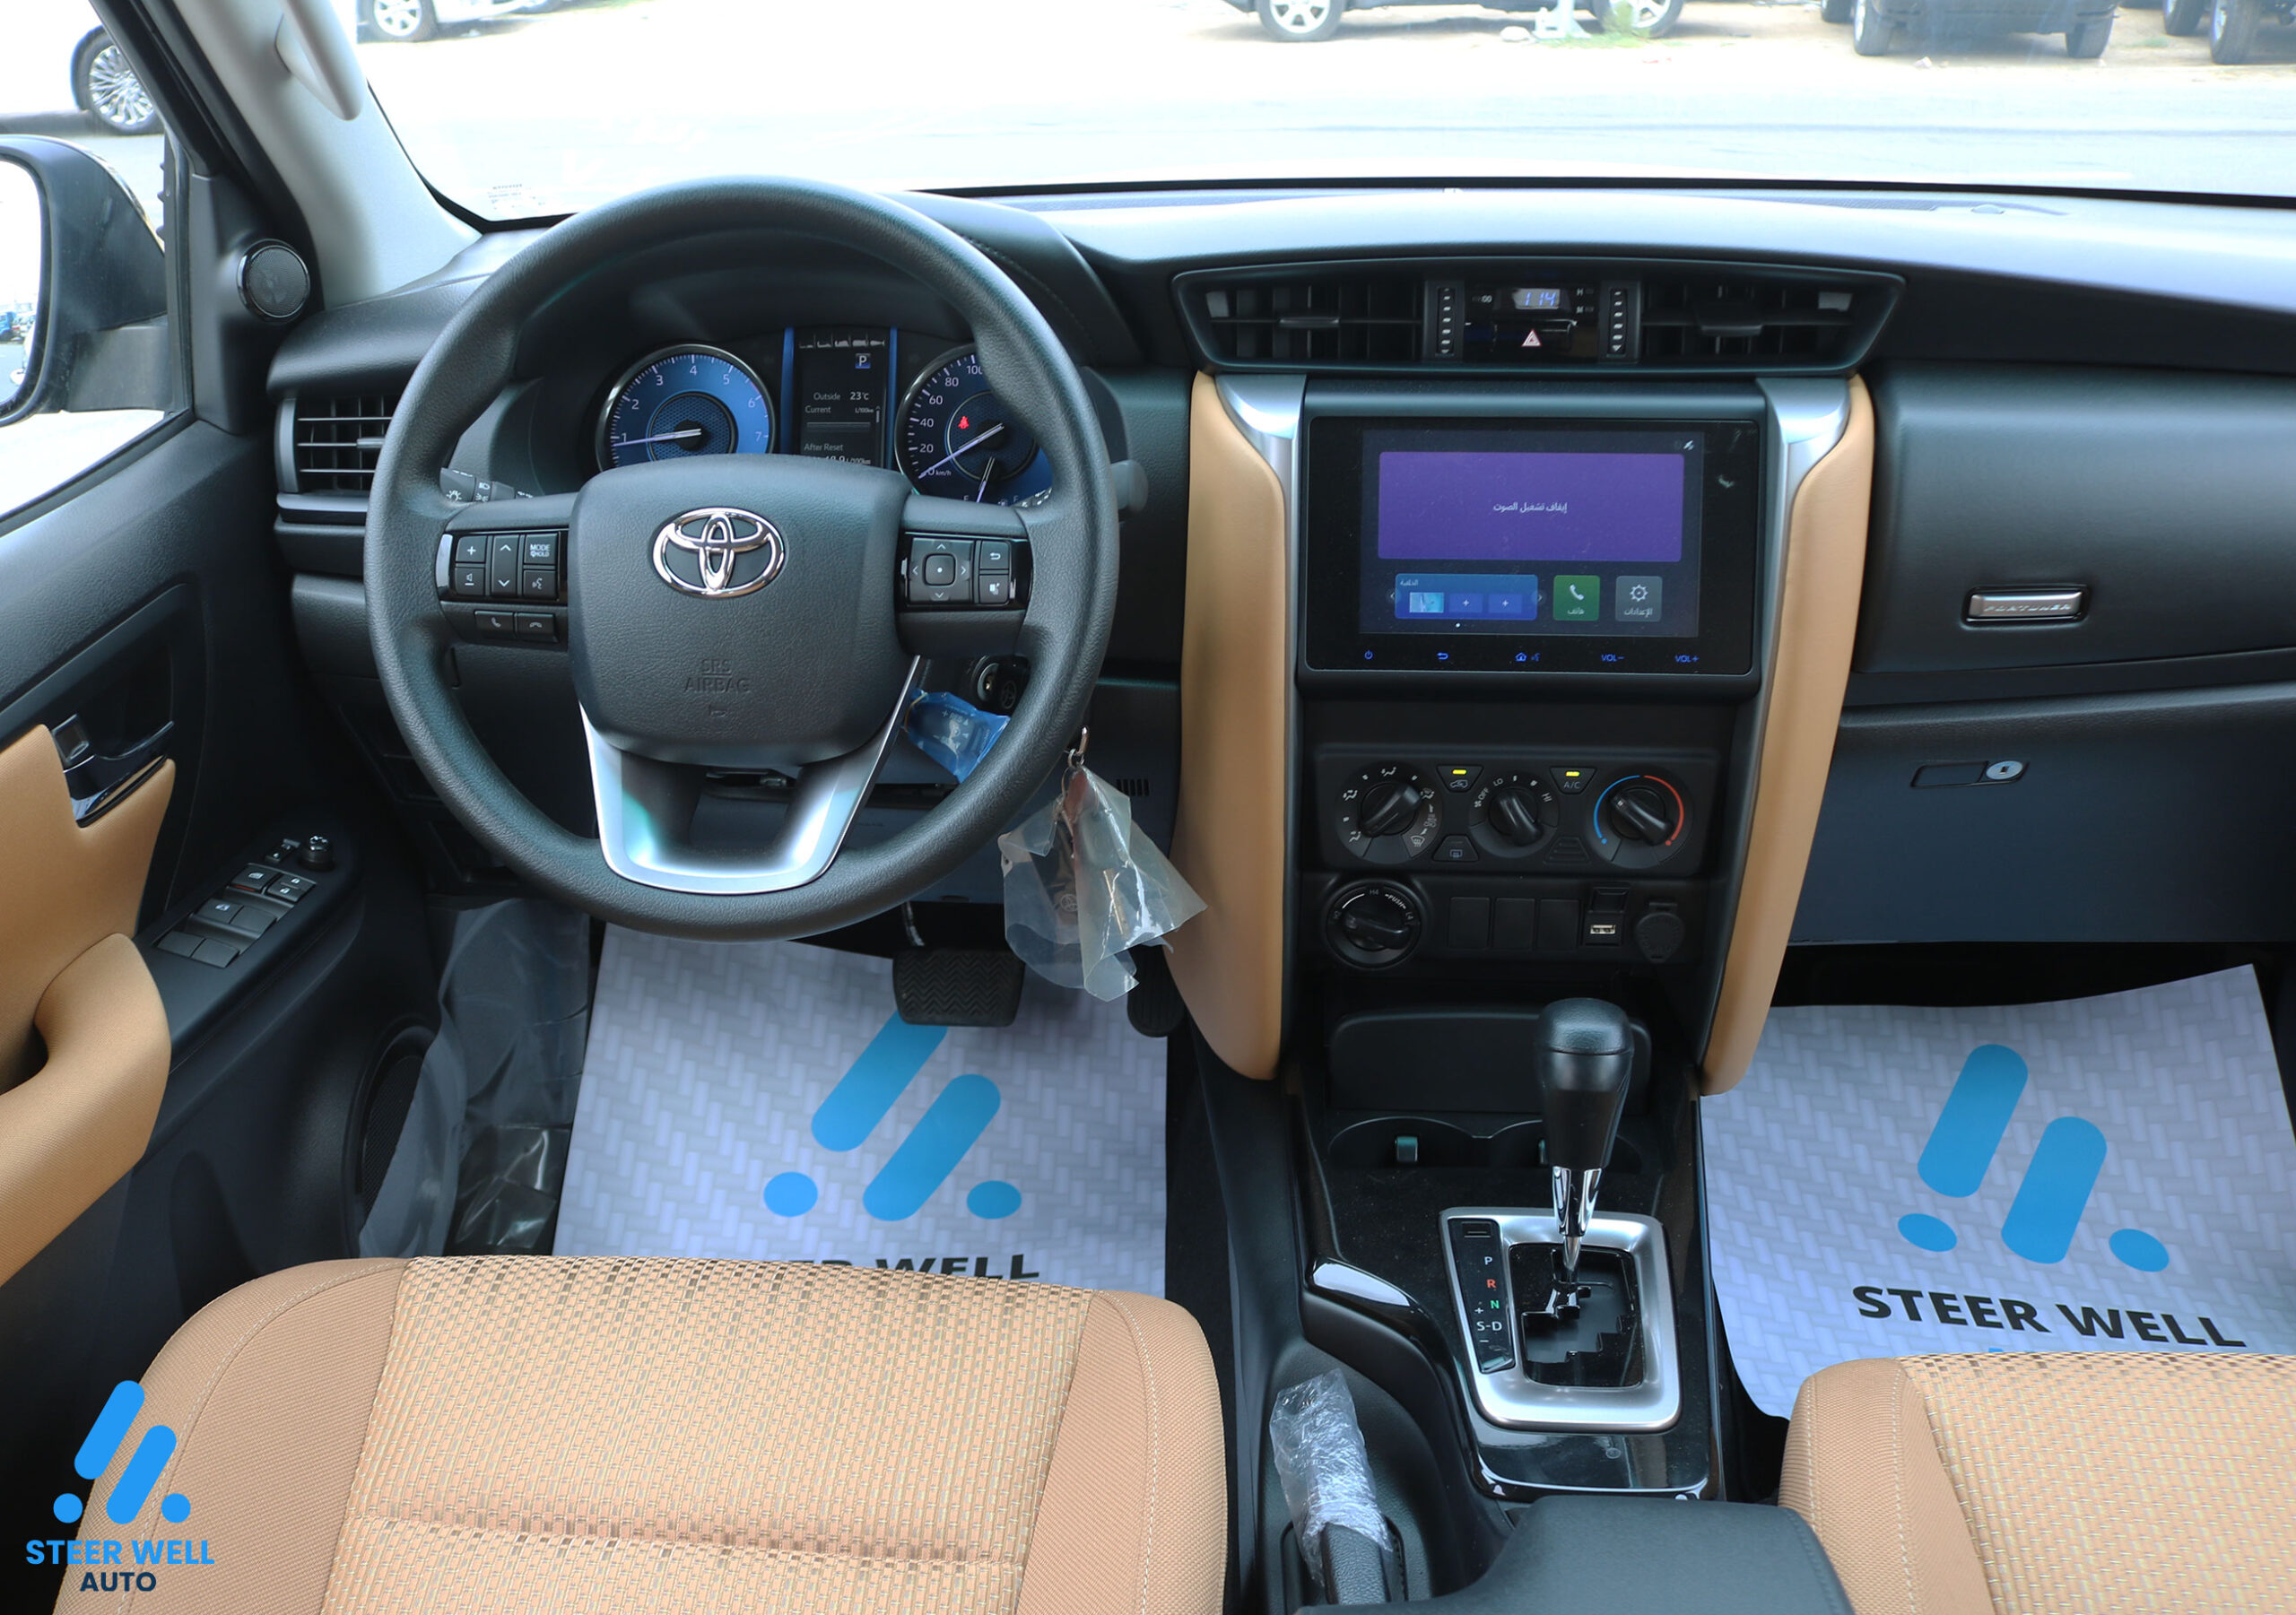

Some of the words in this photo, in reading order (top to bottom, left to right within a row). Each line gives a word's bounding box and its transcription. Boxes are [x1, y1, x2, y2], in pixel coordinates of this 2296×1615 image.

[858, 354, 867, 367] P
[689, 365, 698, 376] 4
[656, 375, 664, 386] 3
[723, 375, 730, 385] 5
[944, 377, 960, 387] 80
[813, 392, 841, 401] Outside
[928, 395, 944, 405] 60
[631, 399, 639, 410] 2
[748, 398, 756, 408] 6
[804, 405, 831, 414] Current
[919, 417, 935, 428] 40
[622, 432, 628, 443] 1
[754, 431, 762, 441] 7
[804, 442, 822, 451] After
[823, 443, 843, 451] Reset
[919, 443, 935, 454] 20
[530, 543, 551, 551] MODE
[683, 677, 751, 693] AIRBAG
[1492, 777, 1504, 787] LO
[1563, 781, 1581, 789] A/C
[1477, 786, 1490, 801] OFF
[1484, 1256, 1493, 1265] P
[1486, 1279, 1497, 1289] R
[1490, 1299, 1500, 1309] N
[1852, 1285, 2051, 1333] STEER
[2055, 1302, 2248, 1347] WELL
